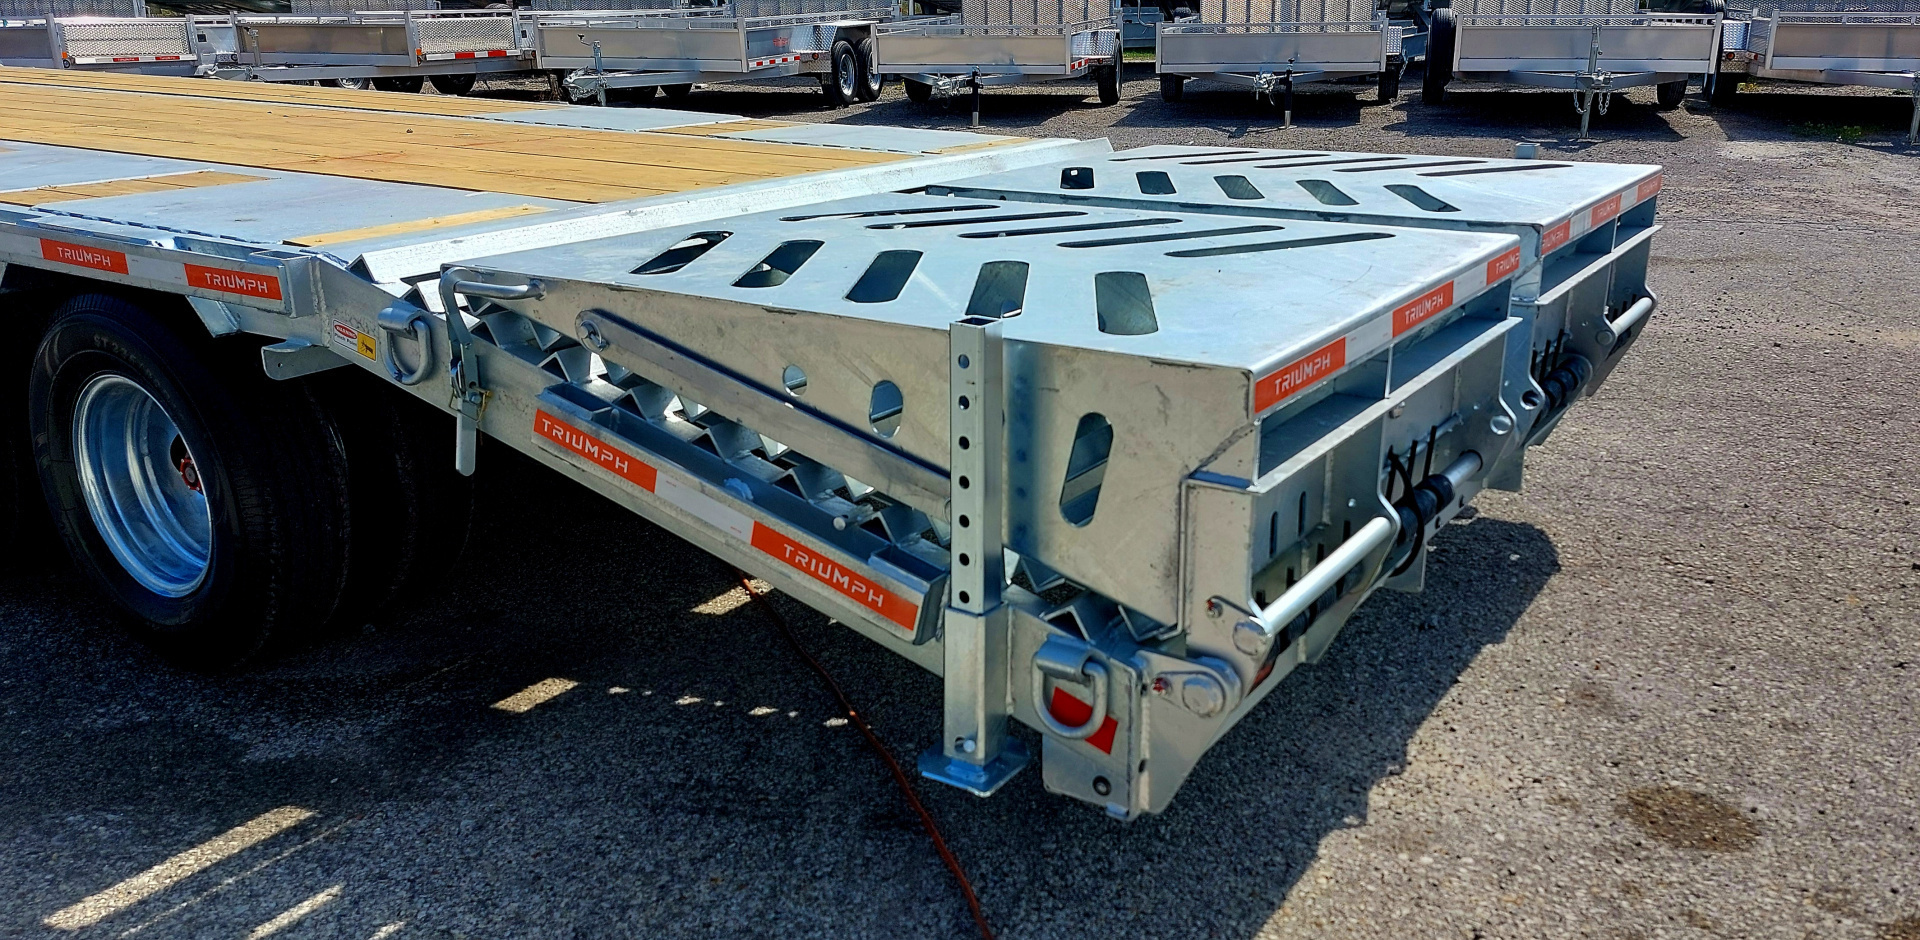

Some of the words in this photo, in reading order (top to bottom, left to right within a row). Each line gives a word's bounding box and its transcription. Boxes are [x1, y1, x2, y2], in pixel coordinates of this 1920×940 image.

[57, 247, 111, 267] TRIUMPH
[1496, 252, 1519, 274] TRIUMP
[205, 272, 268, 294] TRIUMPH
[1405, 292, 1443, 325] TRIUMPH
[336, 325, 357, 339] WARNING
[1275, 352, 1331, 396] TRIUMPH
[542, 418, 628, 473] TRIUMPH
[784, 543, 883, 608] TRIUMPH
